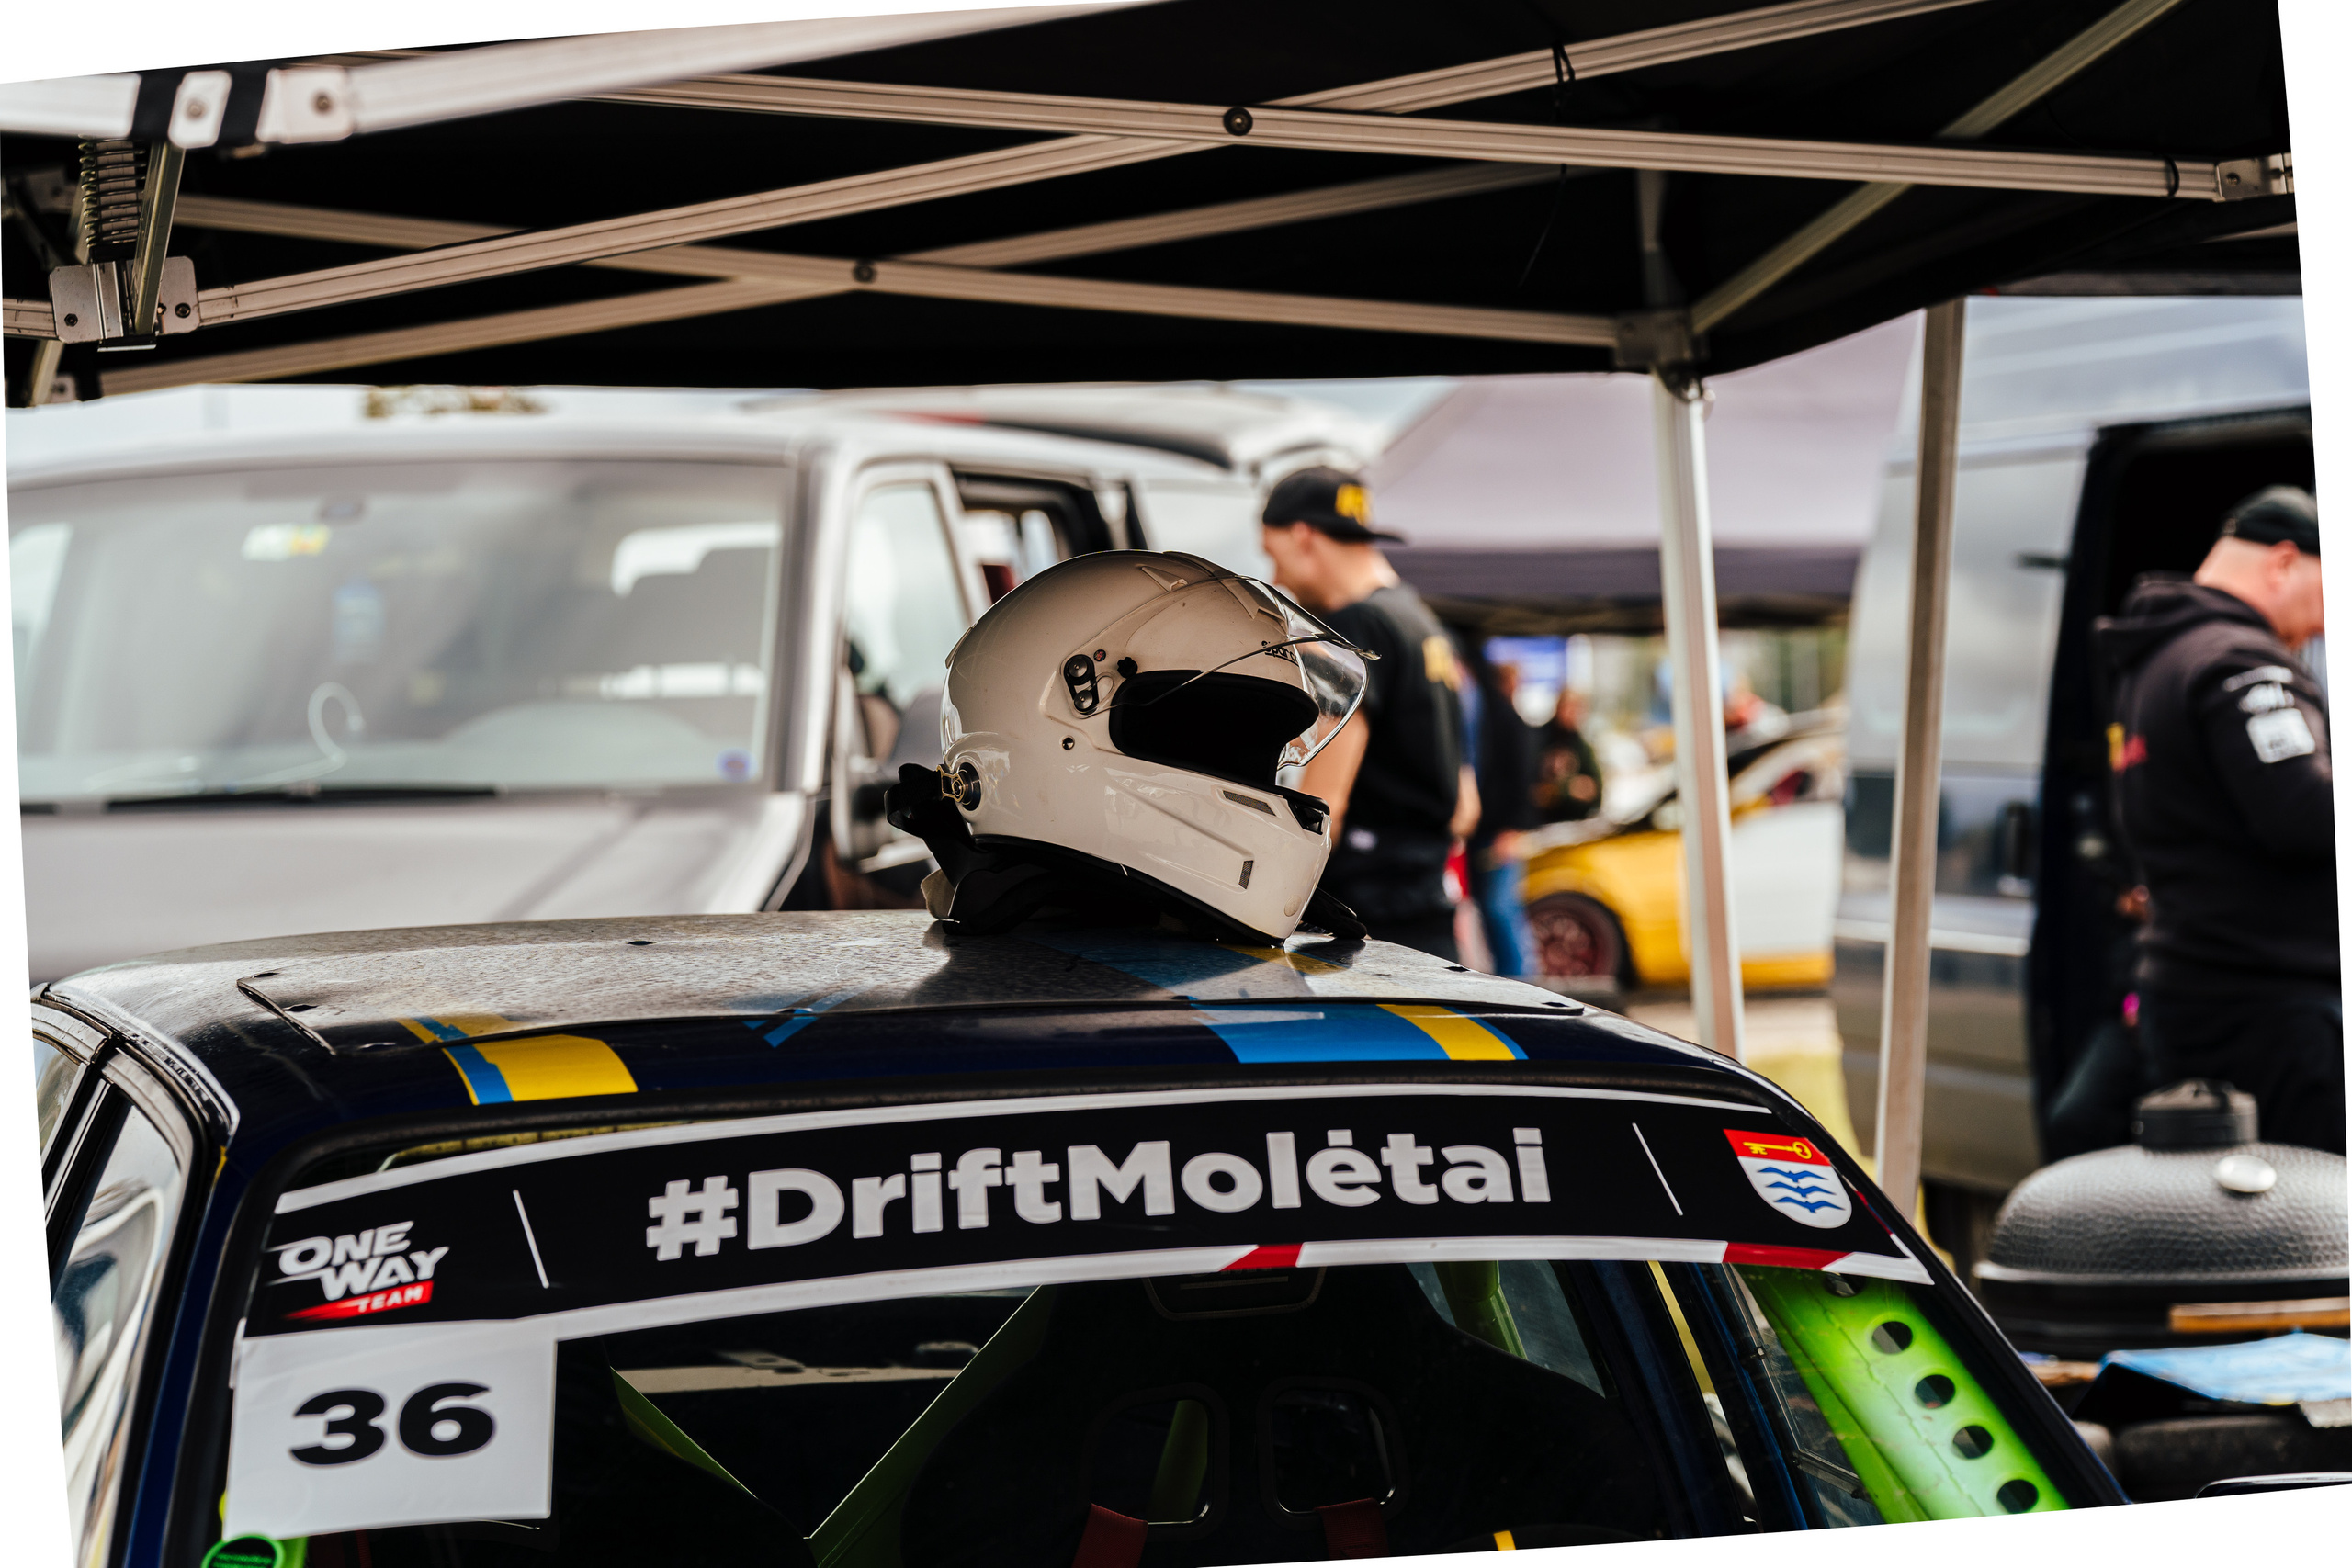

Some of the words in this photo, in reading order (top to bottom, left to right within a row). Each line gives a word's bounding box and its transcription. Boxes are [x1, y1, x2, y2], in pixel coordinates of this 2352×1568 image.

[1261, 640, 1298, 663] Sparc
[646, 1127, 1551, 1262] #DriftMolėtai
[274, 1220, 414, 1276] ONE
[317, 1246, 450, 1302] WAY
[356, 1285, 424, 1314] TEAM
[288, 1382, 497, 1467] 36
